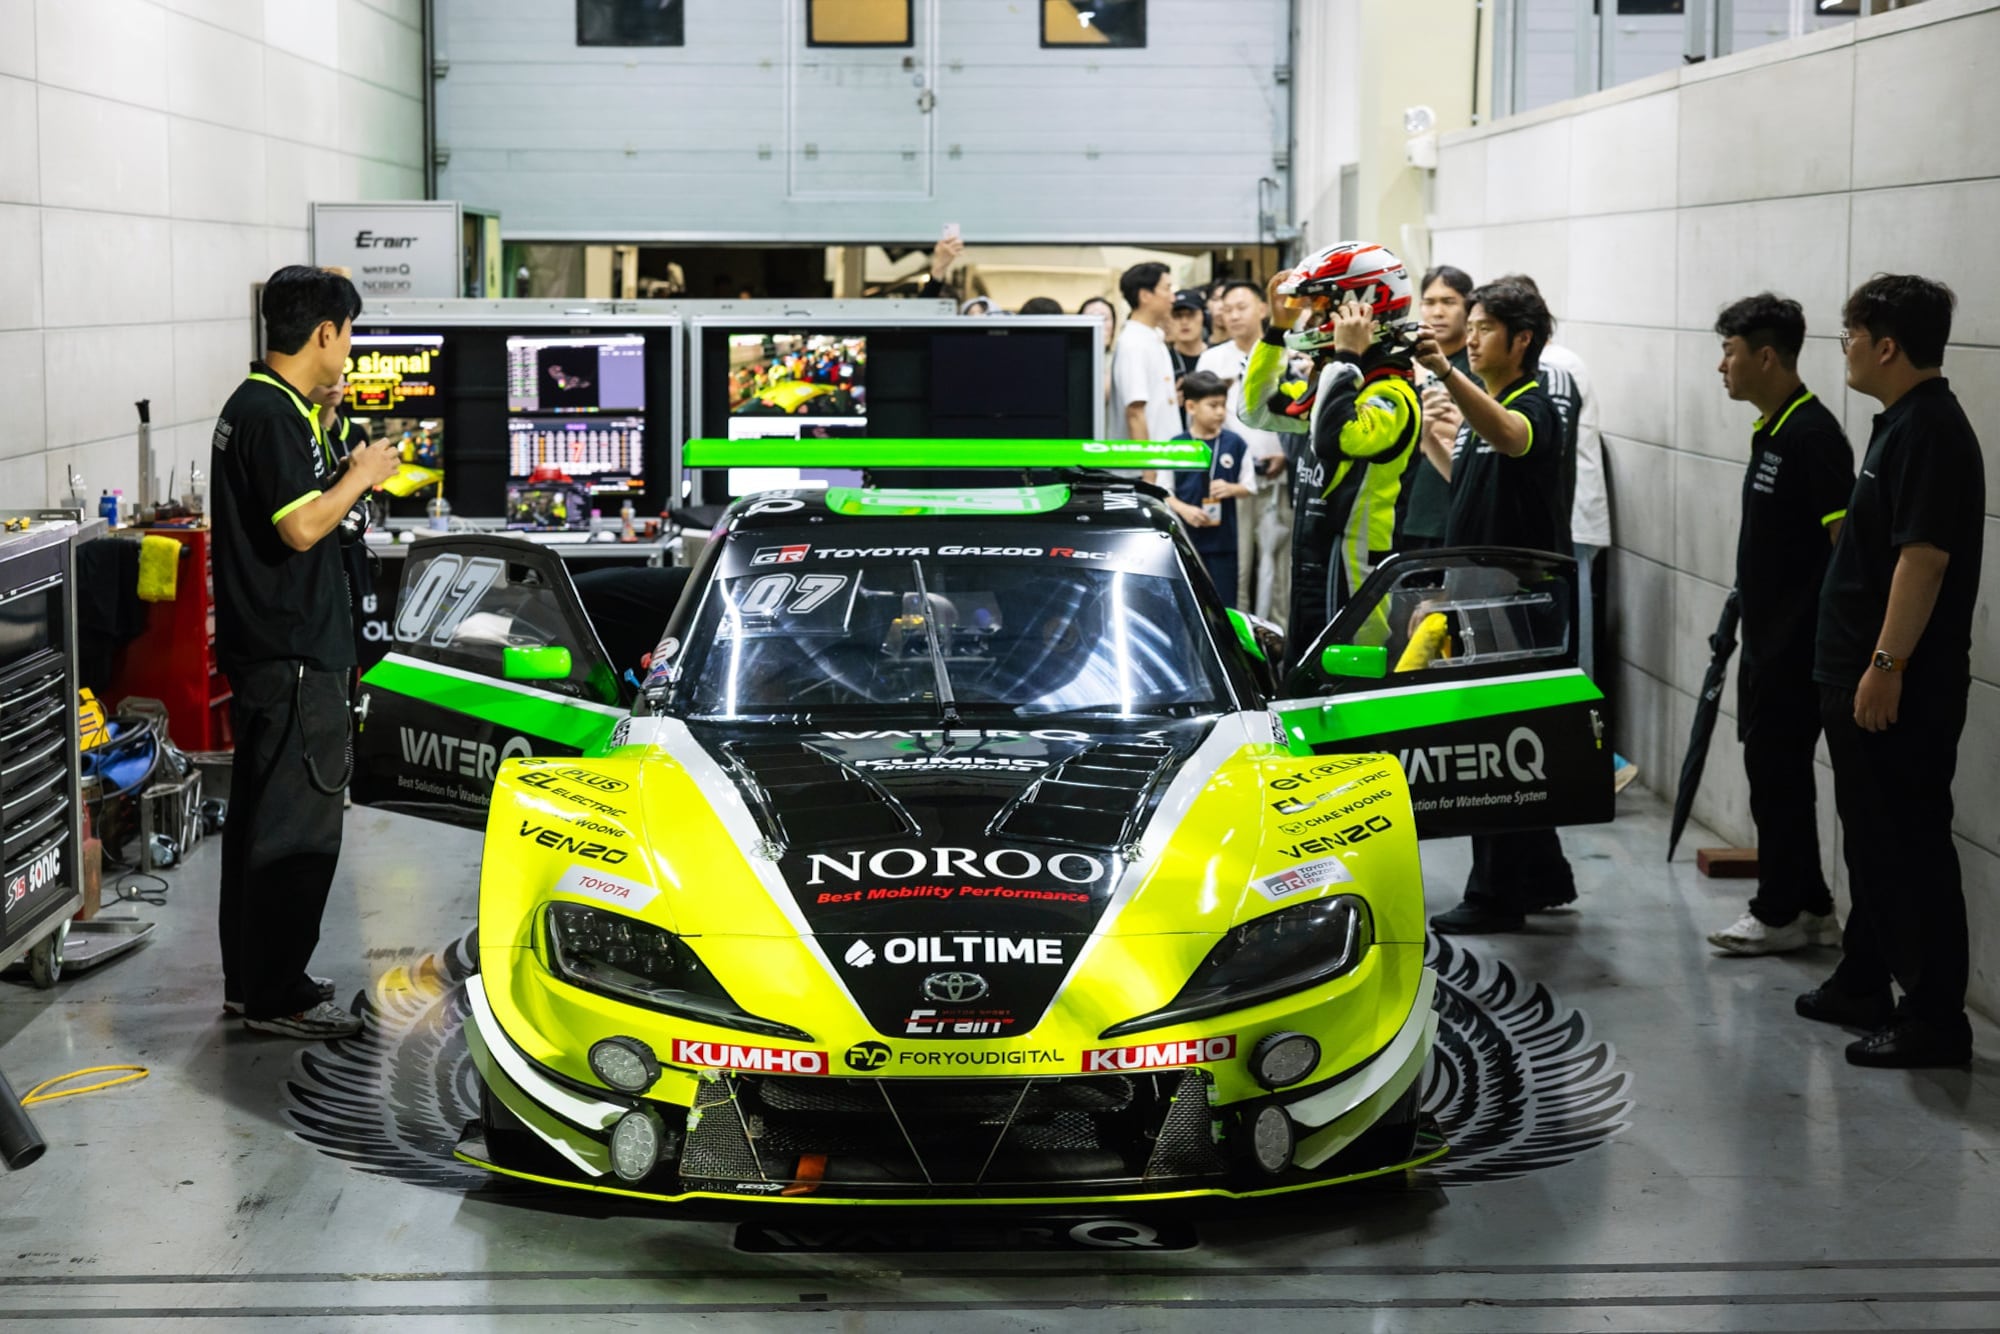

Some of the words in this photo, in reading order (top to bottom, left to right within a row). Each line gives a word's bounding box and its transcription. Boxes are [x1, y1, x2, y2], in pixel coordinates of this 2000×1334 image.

[357, 351, 430, 380] signal
[753, 550, 805, 564] GR
[815, 547, 930, 560] TOYOTA
[937, 545, 1044, 557] GAZOO
[395, 552, 506, 649] 07
[739, 573, 849, 617] 07
[820, 729, 1092, 742] WATERQ
[855, 757, 1050, 767] KUMHO
[563, 769, 620, 790] PLUS
[550, 787, 628, 817] ELECTRIC
[1438, 796, 1455, 809] for
[1456, 794, 1513, 808] Waterborne
[1513, 791, 1548, 805] System
[518, 820, 628, 864] VENZO
[1277, 815, 1393, 859] VENZO
[29, 847, 60, 893] SONIC
[806, 847, 1105, 885] NOROO
[579, 876, 631, 898] TOYOTA
[816, 891, 861, 904] Best
[866, 886, 954, 900] Mobility
[958, 885, 1090, 902] Performance
[884, 936, 1063, 965] OILTIME
[679, 1040, 822, 1073] KUMHO
[900, 1050, 1065, 1065] FORYOUDIGITAL
[1089, 1037, 1232, 1071] KUMHO
